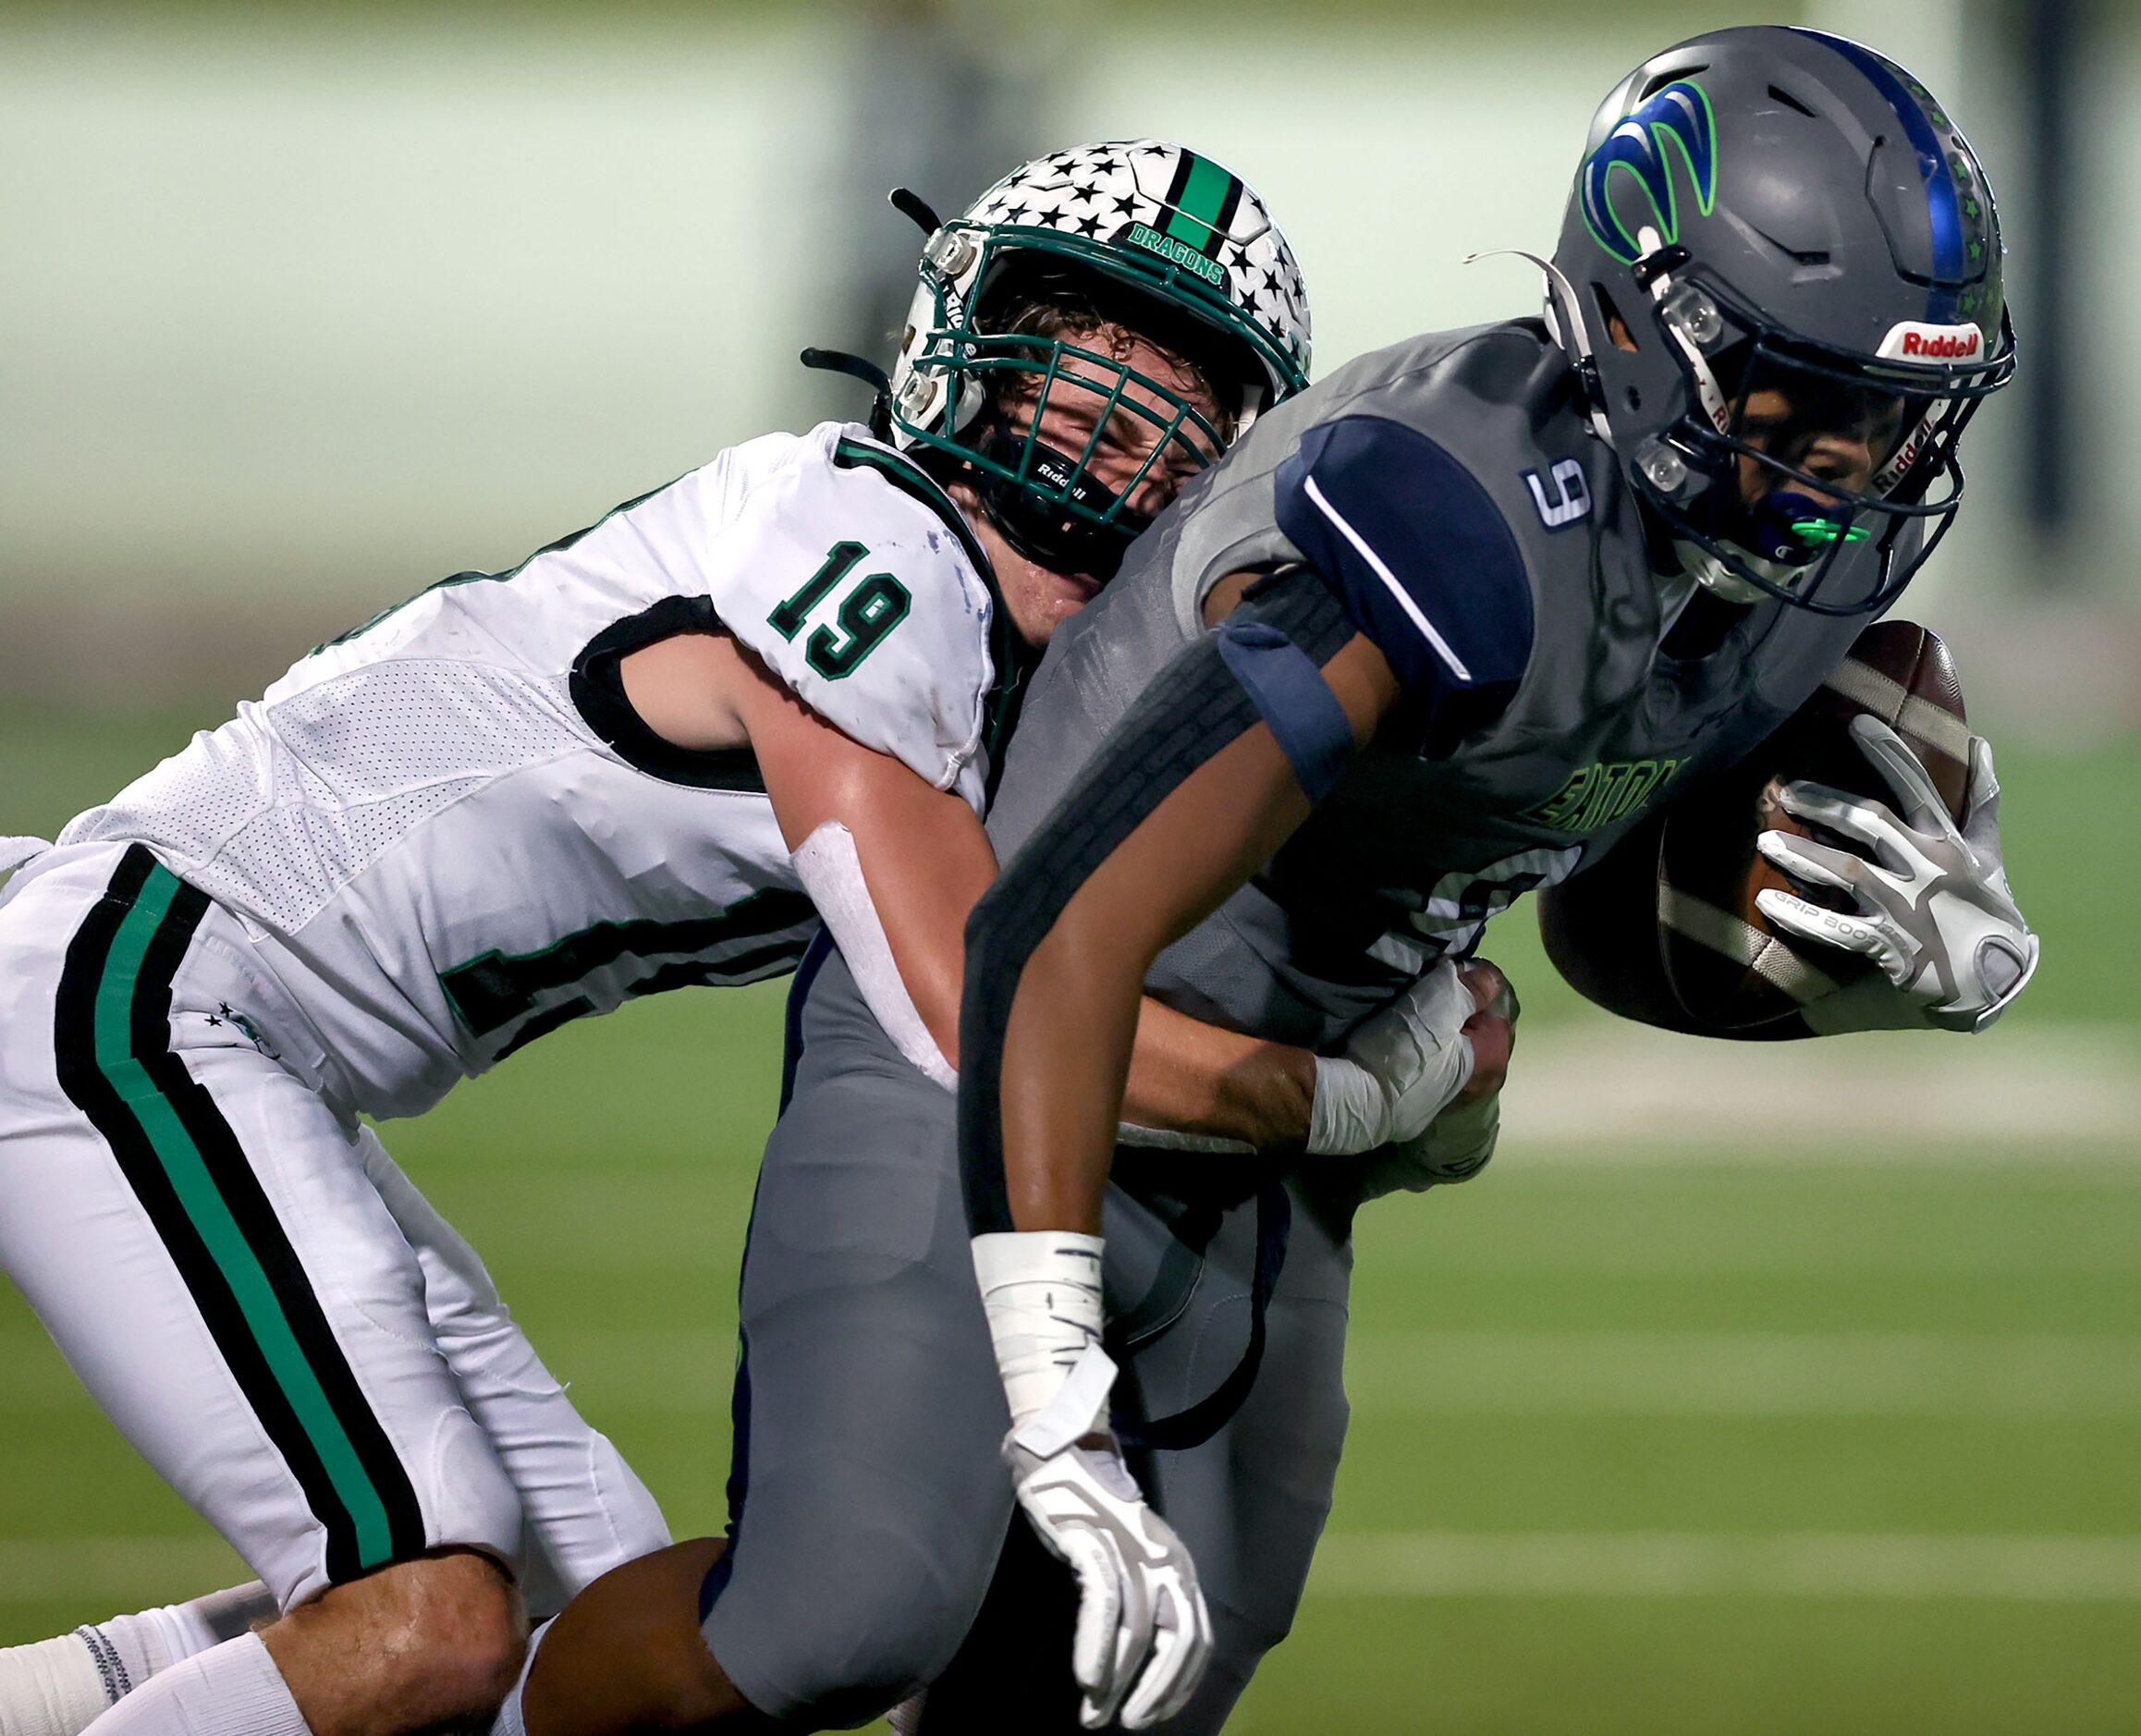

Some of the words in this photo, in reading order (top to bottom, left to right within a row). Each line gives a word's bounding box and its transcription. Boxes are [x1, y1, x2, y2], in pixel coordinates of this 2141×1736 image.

[1128, 222, 1225, 286] DRAGONS
[1902, 332, 1978, 357] Riddell
[1036, 463, 1087, 500] Riddll
[1522, 456, 1593, 531] 9
[765, 541, 912, 681] 19
[1774, 891, 1820, 918] GRIP
